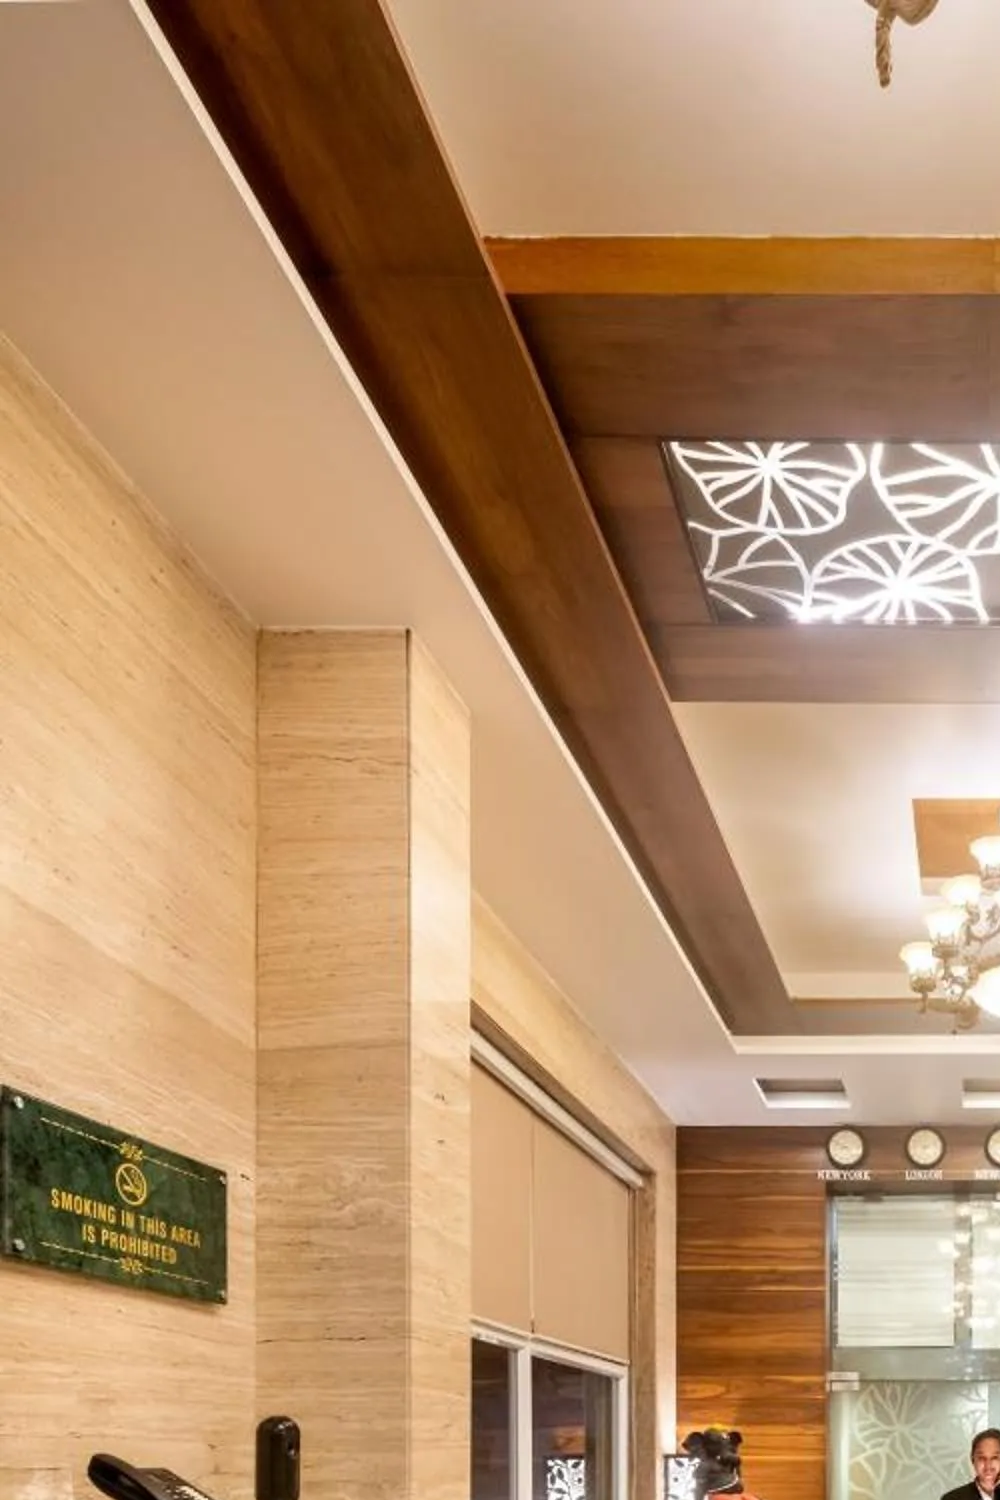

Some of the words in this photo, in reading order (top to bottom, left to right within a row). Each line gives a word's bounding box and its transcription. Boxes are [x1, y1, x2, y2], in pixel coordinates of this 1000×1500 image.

[905, 1170, 943, 1180] LONDON
[51, 1188, 117, 1224] SMOKING
[121, 1210, 135, 1229] IN
[140, 1215, 167, 1239] THIS
[171, 1225, 201, 1249] AREA
[82, 1223, 96, 1243] IS
[101, 1228, 177, 1265] PROHIBITED
